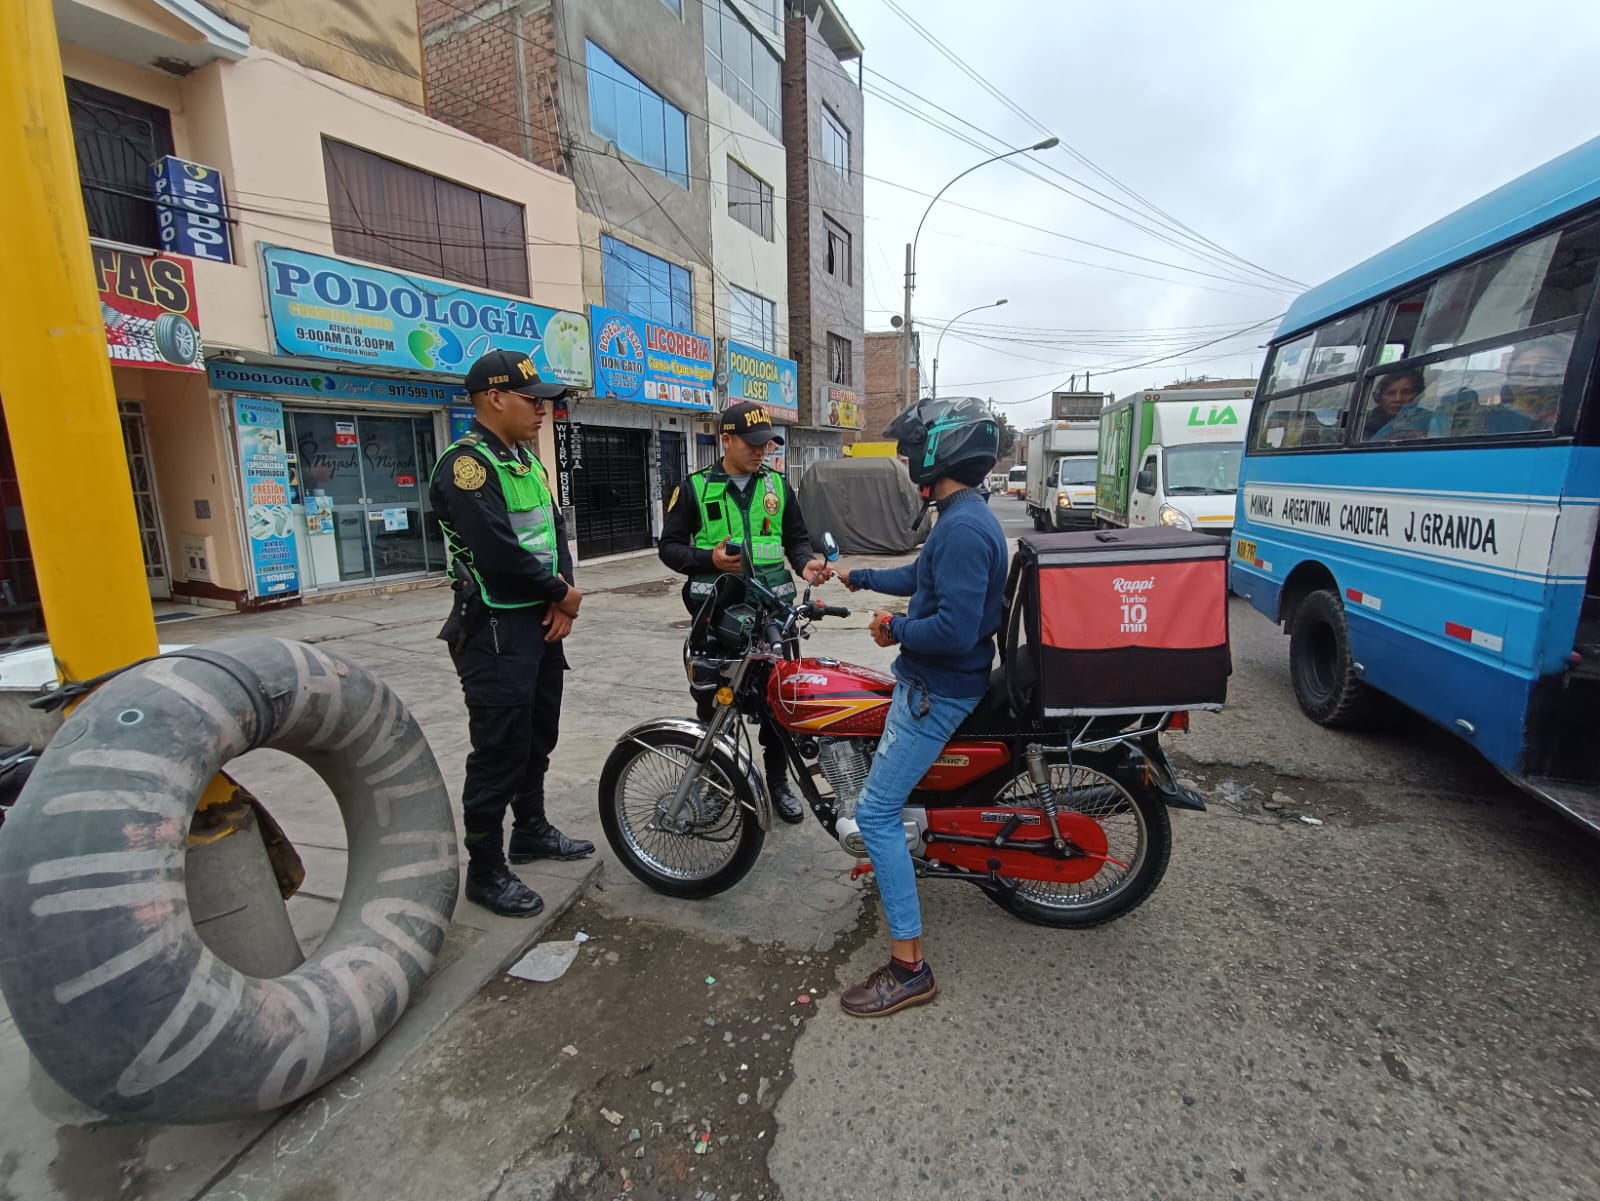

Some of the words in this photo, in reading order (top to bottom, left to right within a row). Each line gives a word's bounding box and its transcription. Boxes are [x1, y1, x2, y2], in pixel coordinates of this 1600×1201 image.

[271, 260, 542, 340] PODOLOGÍA
[296, 327, 342, 345] 9:00AM
[344, 334, 352, 346] A
[354, 334, 395, 352] 8:00PM
[599, 320, 621, 353] BODEGA
[625, 324, 644, 359] BAZAR
[600, 356, 620, 370] DON
[622, 360, 643, 374] GATO
[488, 375, 509, 385] PERU
[388, 384, 406, 397] 917
[408, 385, 428, 398] 599
[430, 387, 446, 400] 113
[555, 424, 567, 468] WHISKY
[560, 472, 570, 506] RONES
[1250, 494, 1273, 518] MINKA
[1281, 497, 1331, 527] ARGENTINA
[1339, 503, 1389, 537] CAQUETA
[1112, 576, 1155, 593] Rappi
[1120, 594, 1147, 604] Turbo
[1120, 604, 1147, 624] 10
[1120, 623, 1148, 633] min
